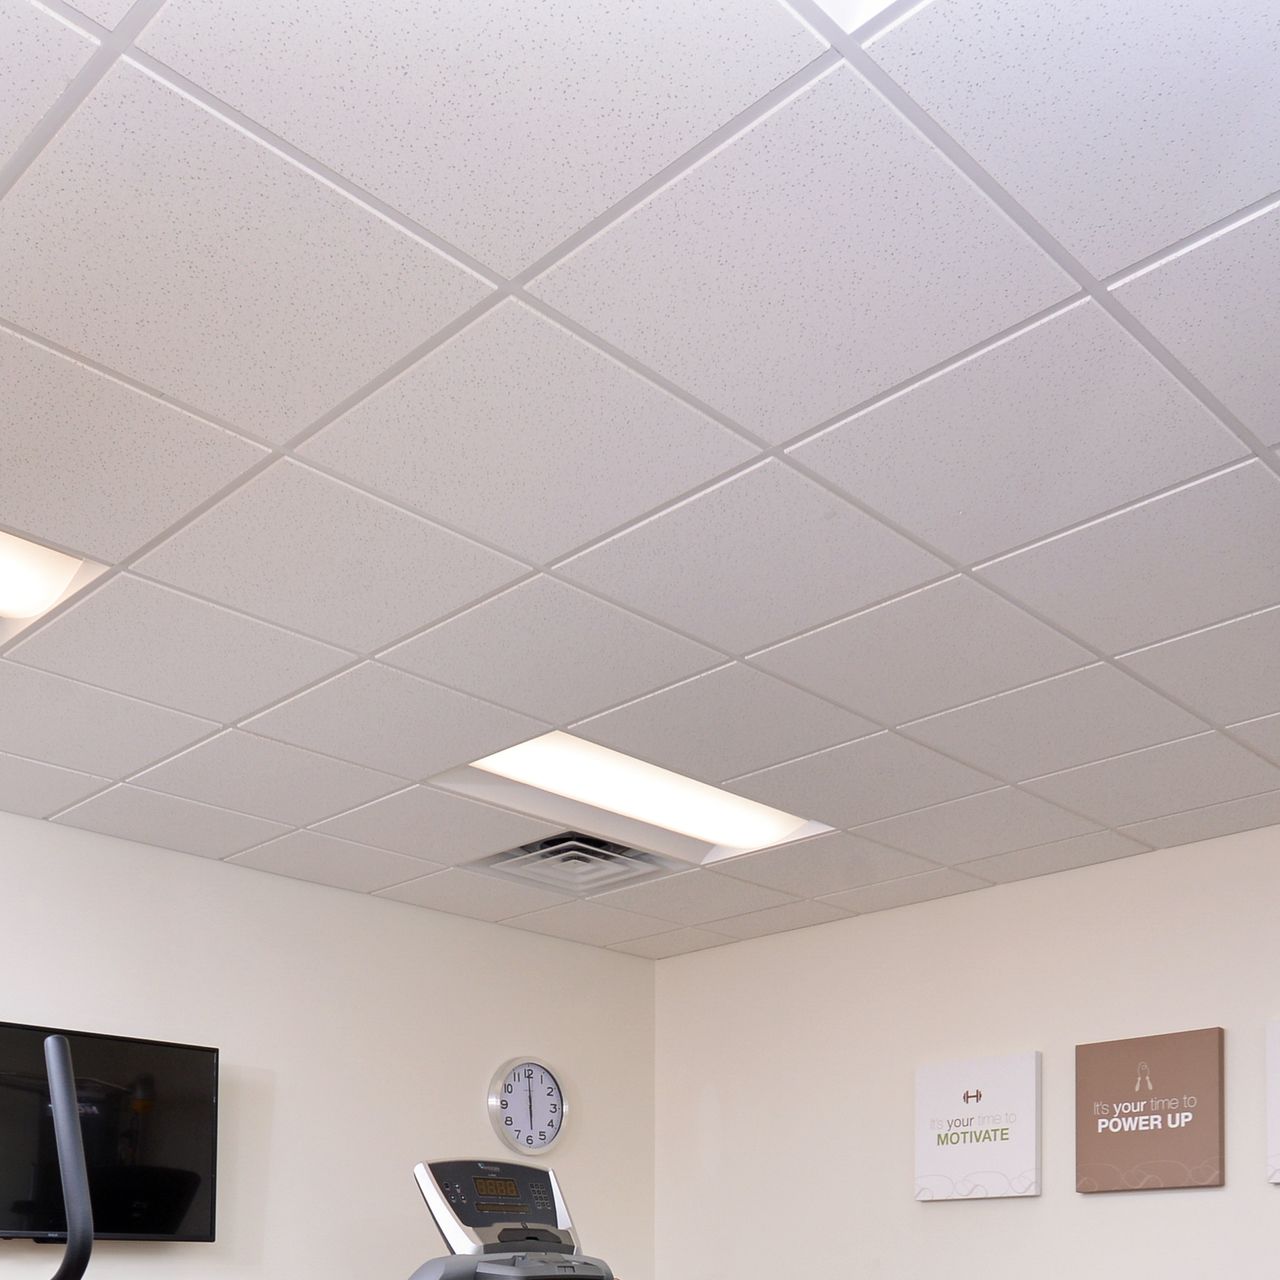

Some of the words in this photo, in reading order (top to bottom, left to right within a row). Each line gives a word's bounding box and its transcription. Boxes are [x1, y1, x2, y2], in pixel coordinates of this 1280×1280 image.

[513, 1071, 521, 1083] 11
[524, 1068, 534, 1079] 12
[504, 1083, 513, 1094] 10
[546, 1086, 554, 1097] 2
[500, 1099, 508, 1110] 9
[549, 1103, 558, 1113] 3
[1093, 1101, 1110, 1115] It's
[1113, 1099, 1146, 1116] your
[1150, 1096, 1179, 1110] time
[1183, 1094, 1198, 1109] to
[504, 1116, 513, 1126] 8
[547, 1119, 554, 1128] 4
[946, 1115, 975, 1131] your
[977, 1112, 1002, 1127] time
[1004, 1112, 1017, 1124] to
[1097, 1114, 1163, 1133] POWER
[1167, 1112, 1193, 1128] UP
[514, 1129, 521, 1140] 7
[526, 1135, 534, 1145] 6
[538, 1131, 547, 1141] 5
[936, 1128, 1010, 1146] MOTIVATE
